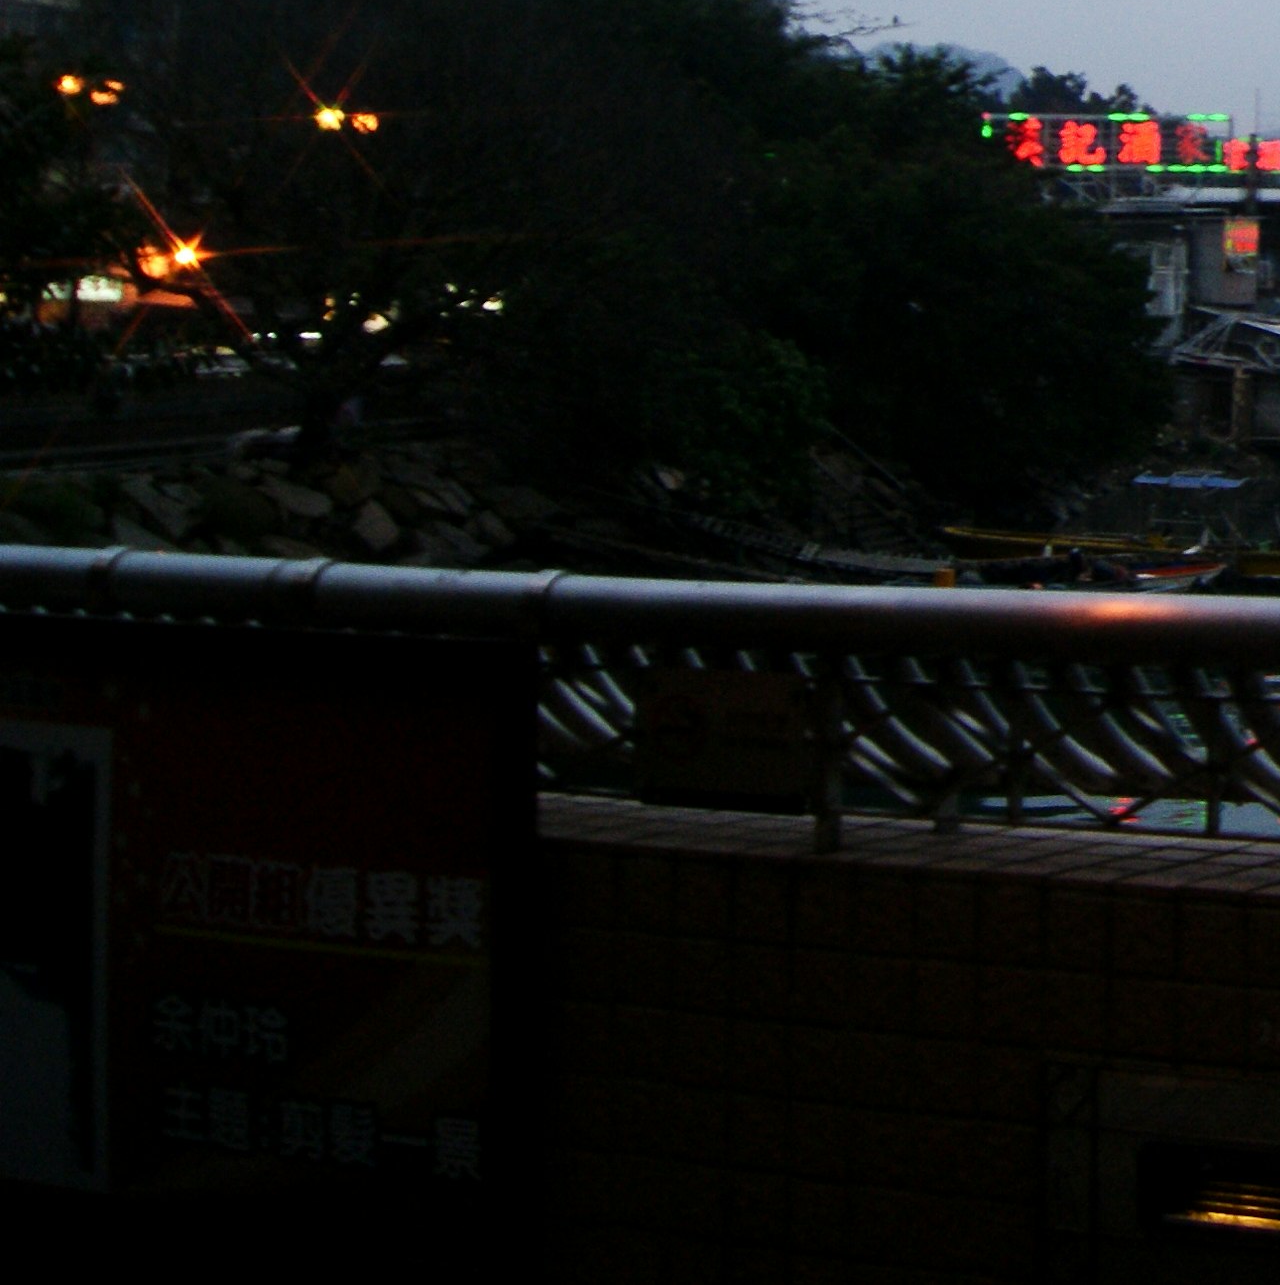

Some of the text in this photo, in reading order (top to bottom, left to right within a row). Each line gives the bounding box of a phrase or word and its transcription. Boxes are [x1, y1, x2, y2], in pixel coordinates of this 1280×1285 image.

[161, 851, 484, 949] 公開組優異獎
